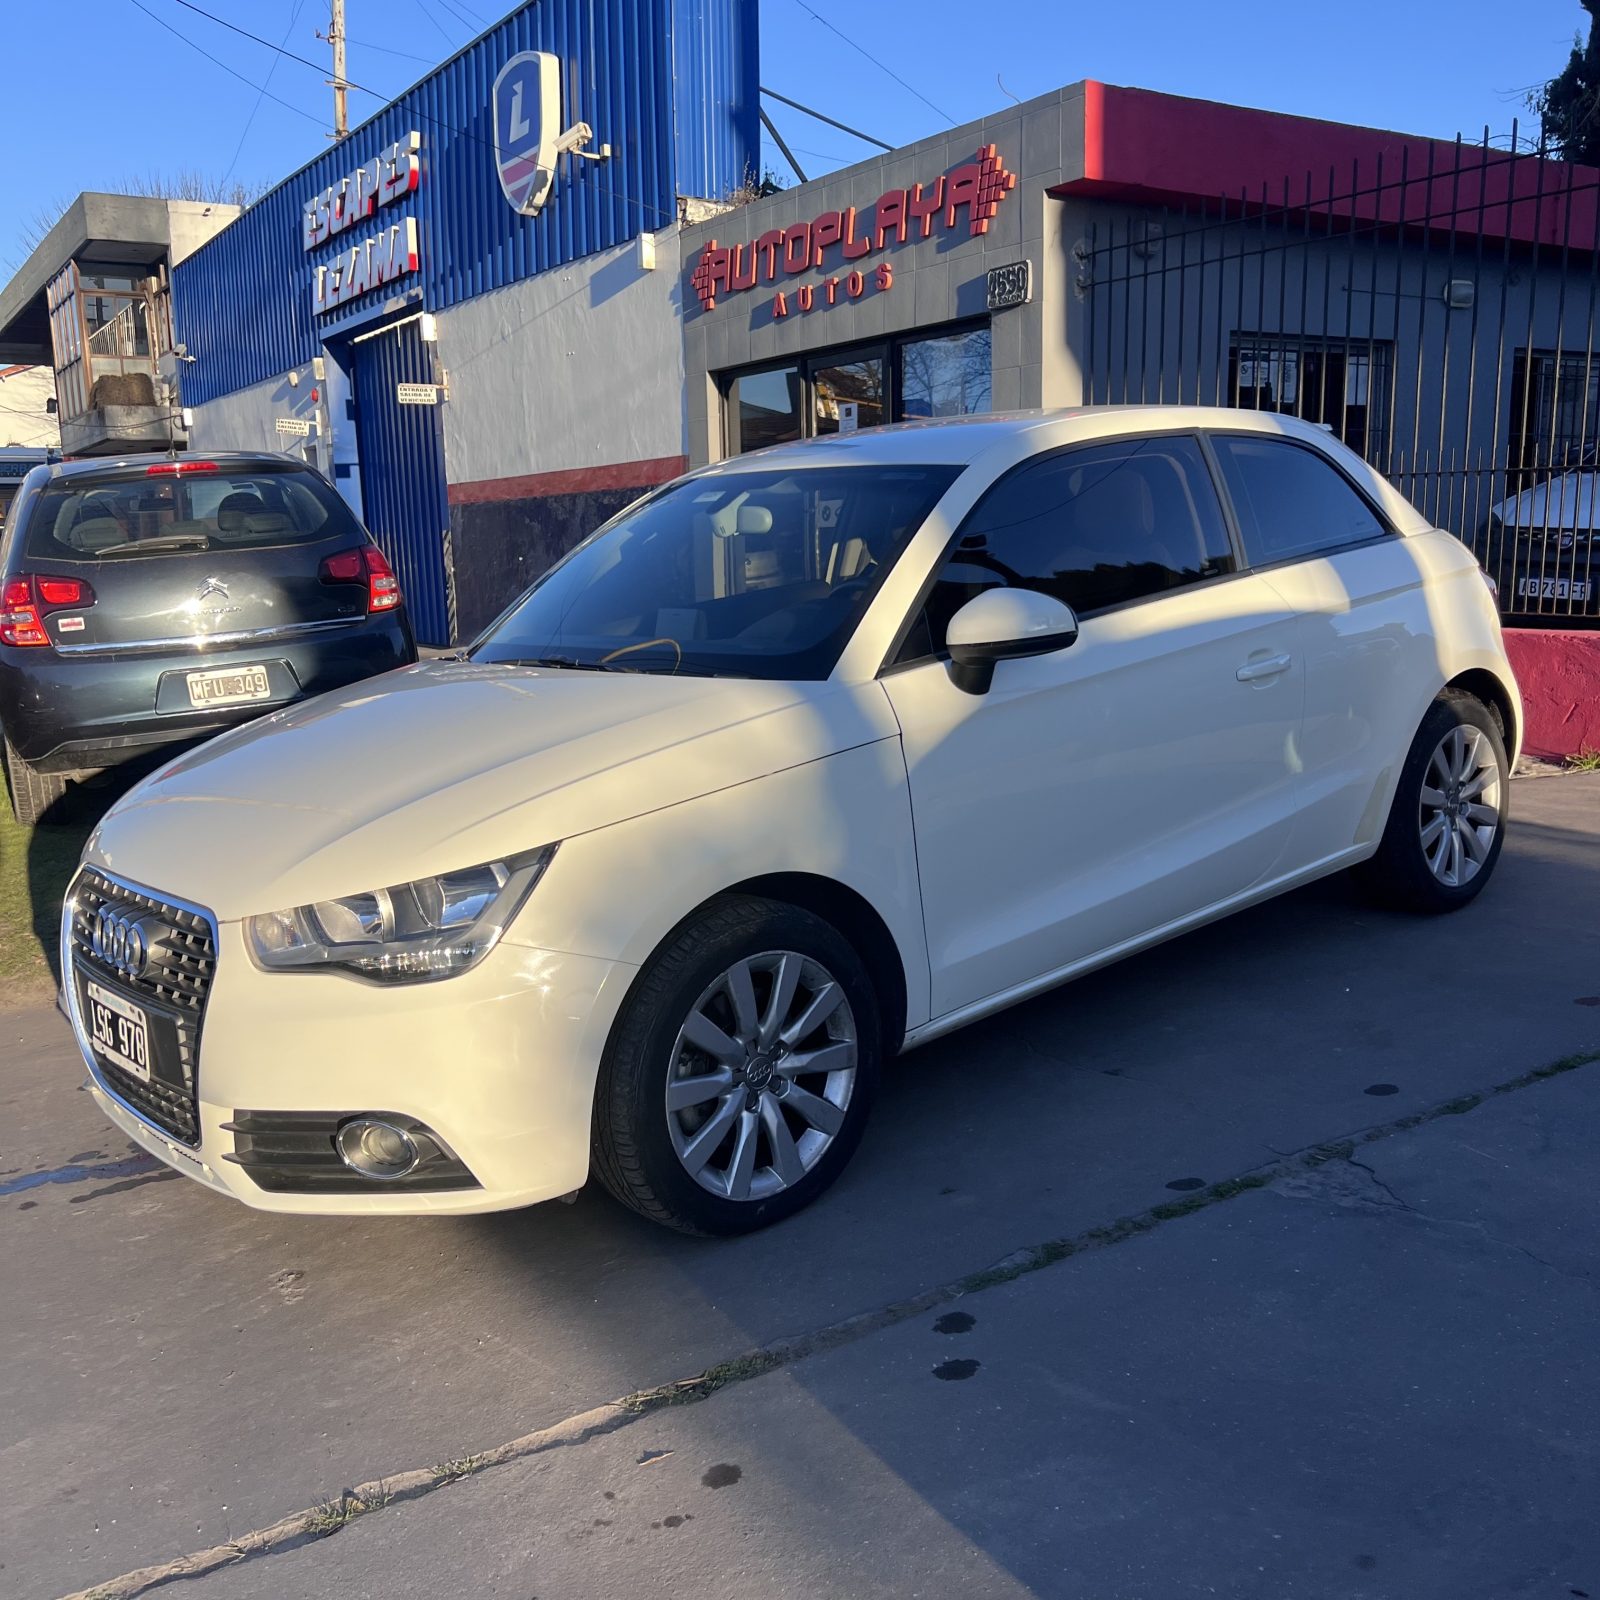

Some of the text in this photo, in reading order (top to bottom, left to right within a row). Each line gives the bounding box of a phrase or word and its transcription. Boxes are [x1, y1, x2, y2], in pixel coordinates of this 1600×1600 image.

[509, 80, 530, 144] L
[303, 131, 420, 251] ESCAPES
[707, 164, 982, 293] AUTOPLAYA
[313, 217, 418, 316] LEZAMA
[773, 263, 893, 318] AUTOS
[191, 673, 266, 700] MFU 349
[118, 1017, 145, 1066] 978
